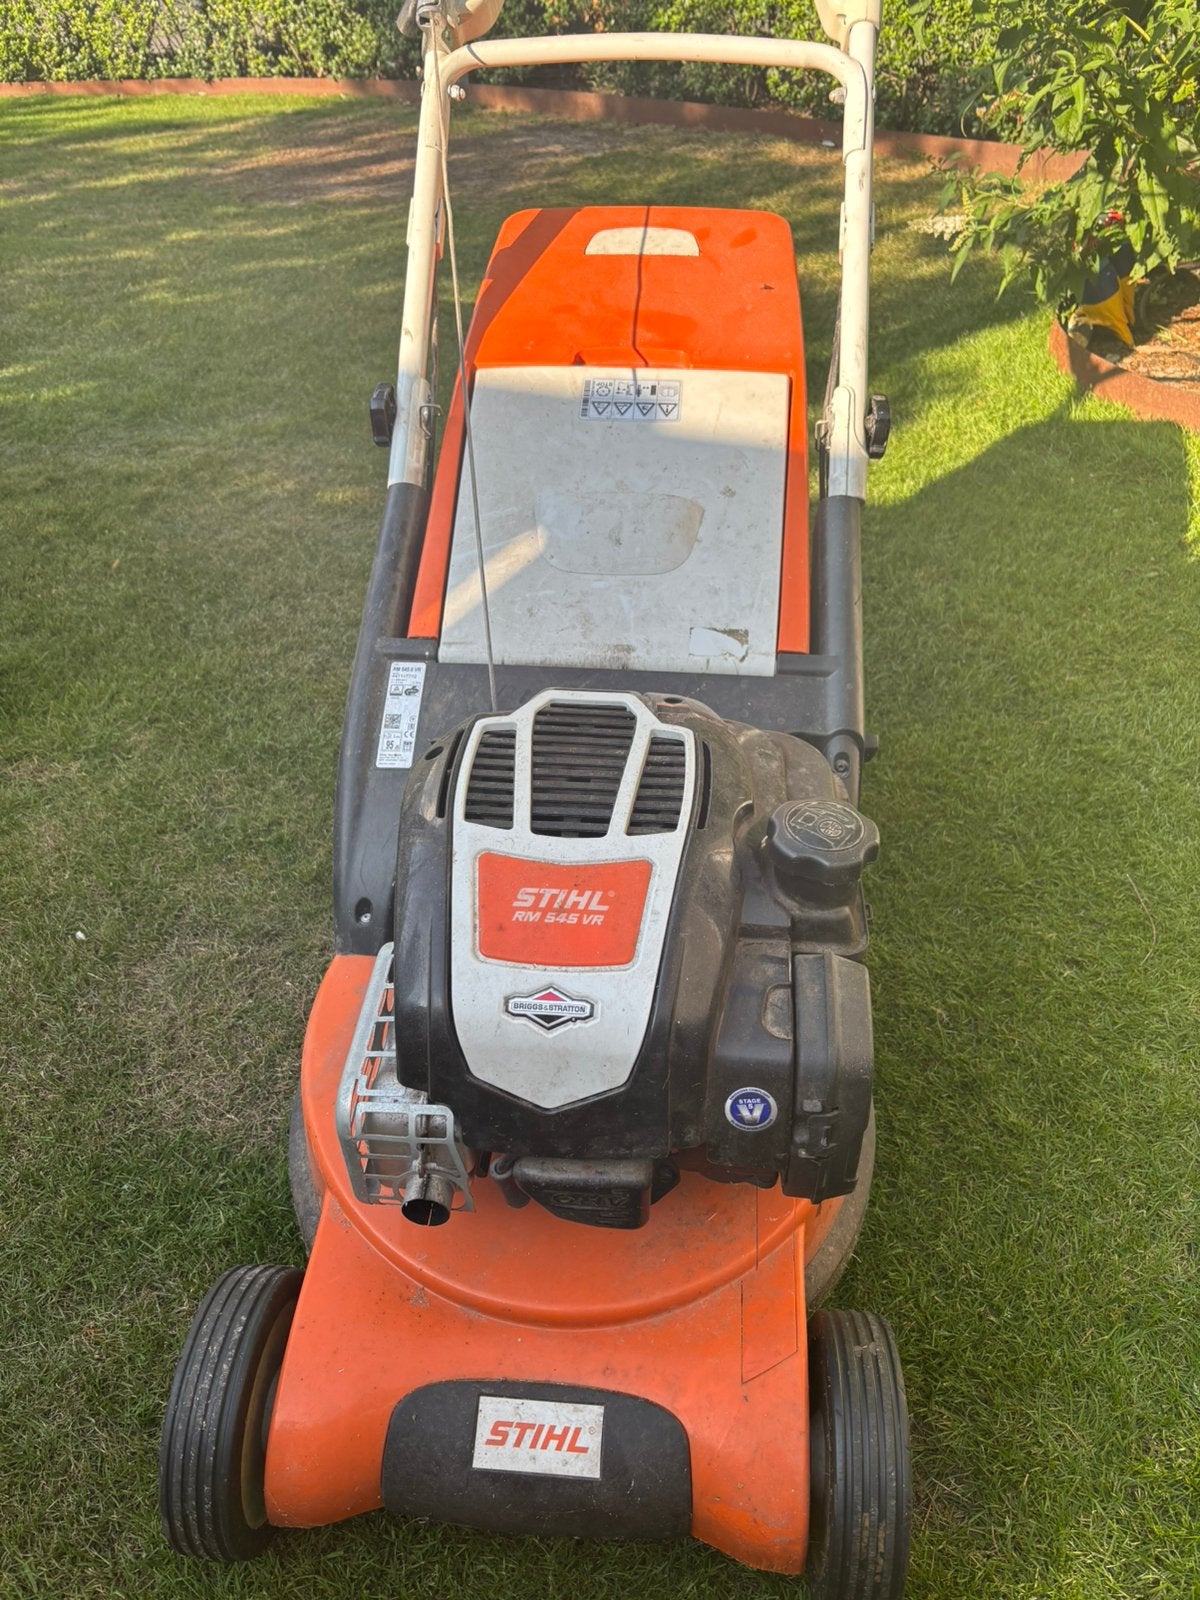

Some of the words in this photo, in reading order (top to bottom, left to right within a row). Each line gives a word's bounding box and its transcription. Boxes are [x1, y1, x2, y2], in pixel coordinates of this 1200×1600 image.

[386, 741, 395, 750] 95
[512, 887, 609, 911] STIHL
[512, 911, 541, 922] RM
[544, 912, 578, 924] 545
[582, 914, 604, 926] VR
[484, 1420, 590, 1454] STIHL
